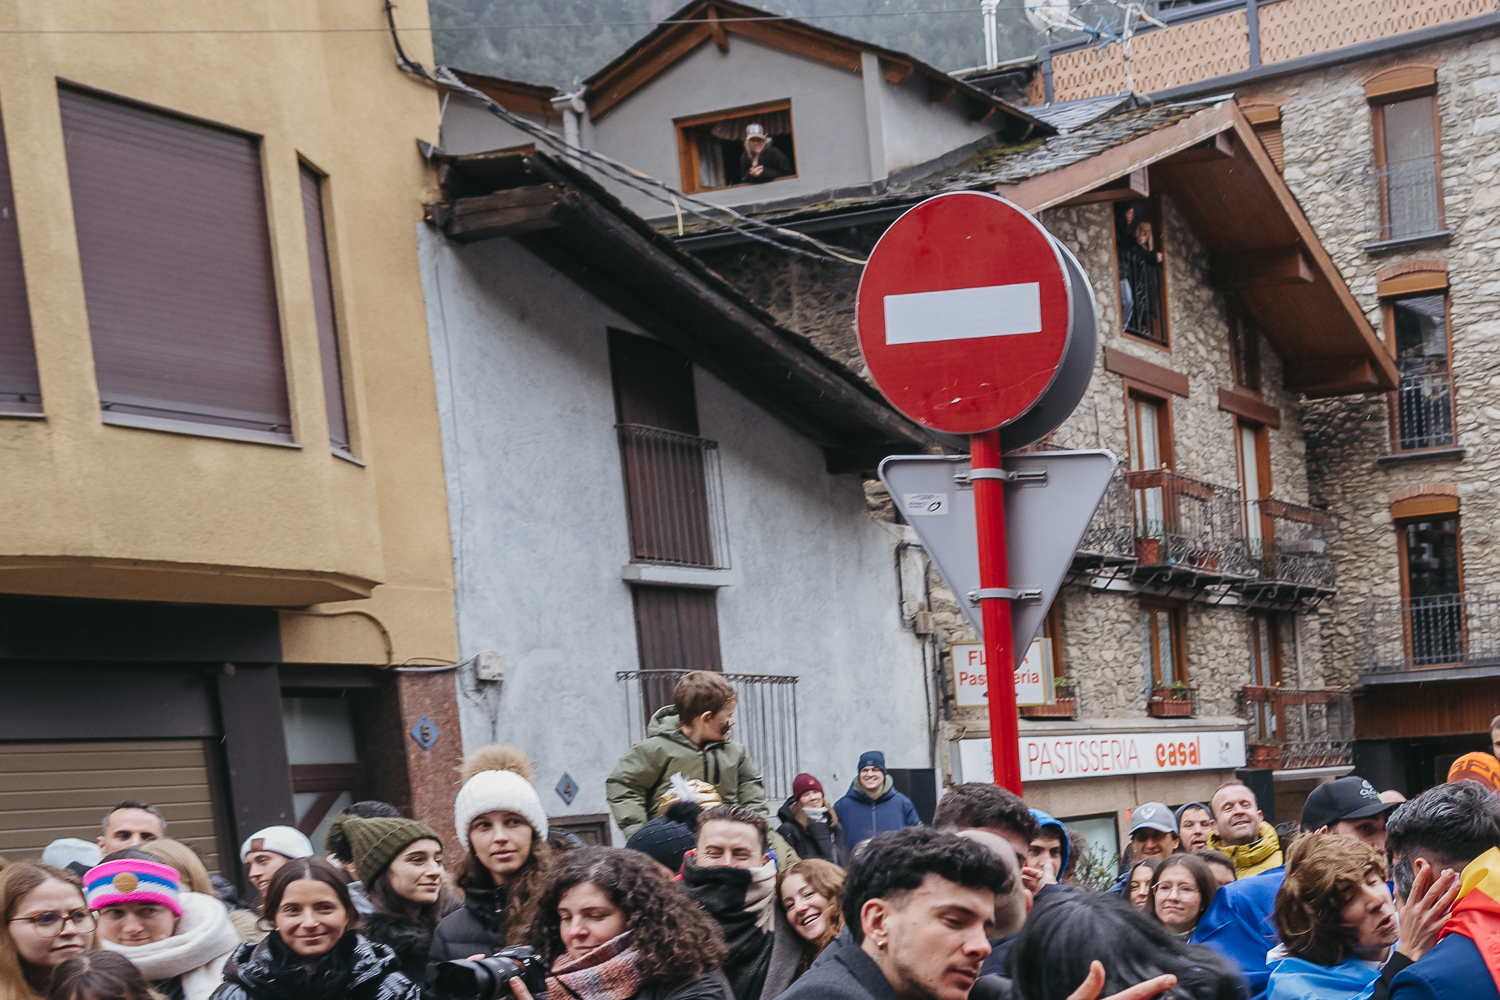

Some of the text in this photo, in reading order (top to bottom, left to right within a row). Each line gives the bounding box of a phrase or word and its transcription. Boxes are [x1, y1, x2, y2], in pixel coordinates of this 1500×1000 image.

[959, 669, 1040, 687] Pasería
[420, 725, 431, 743] 5
[1027, 738, 1142, 776] PASTISSERIA
[564, 781, 573, 797] 4
